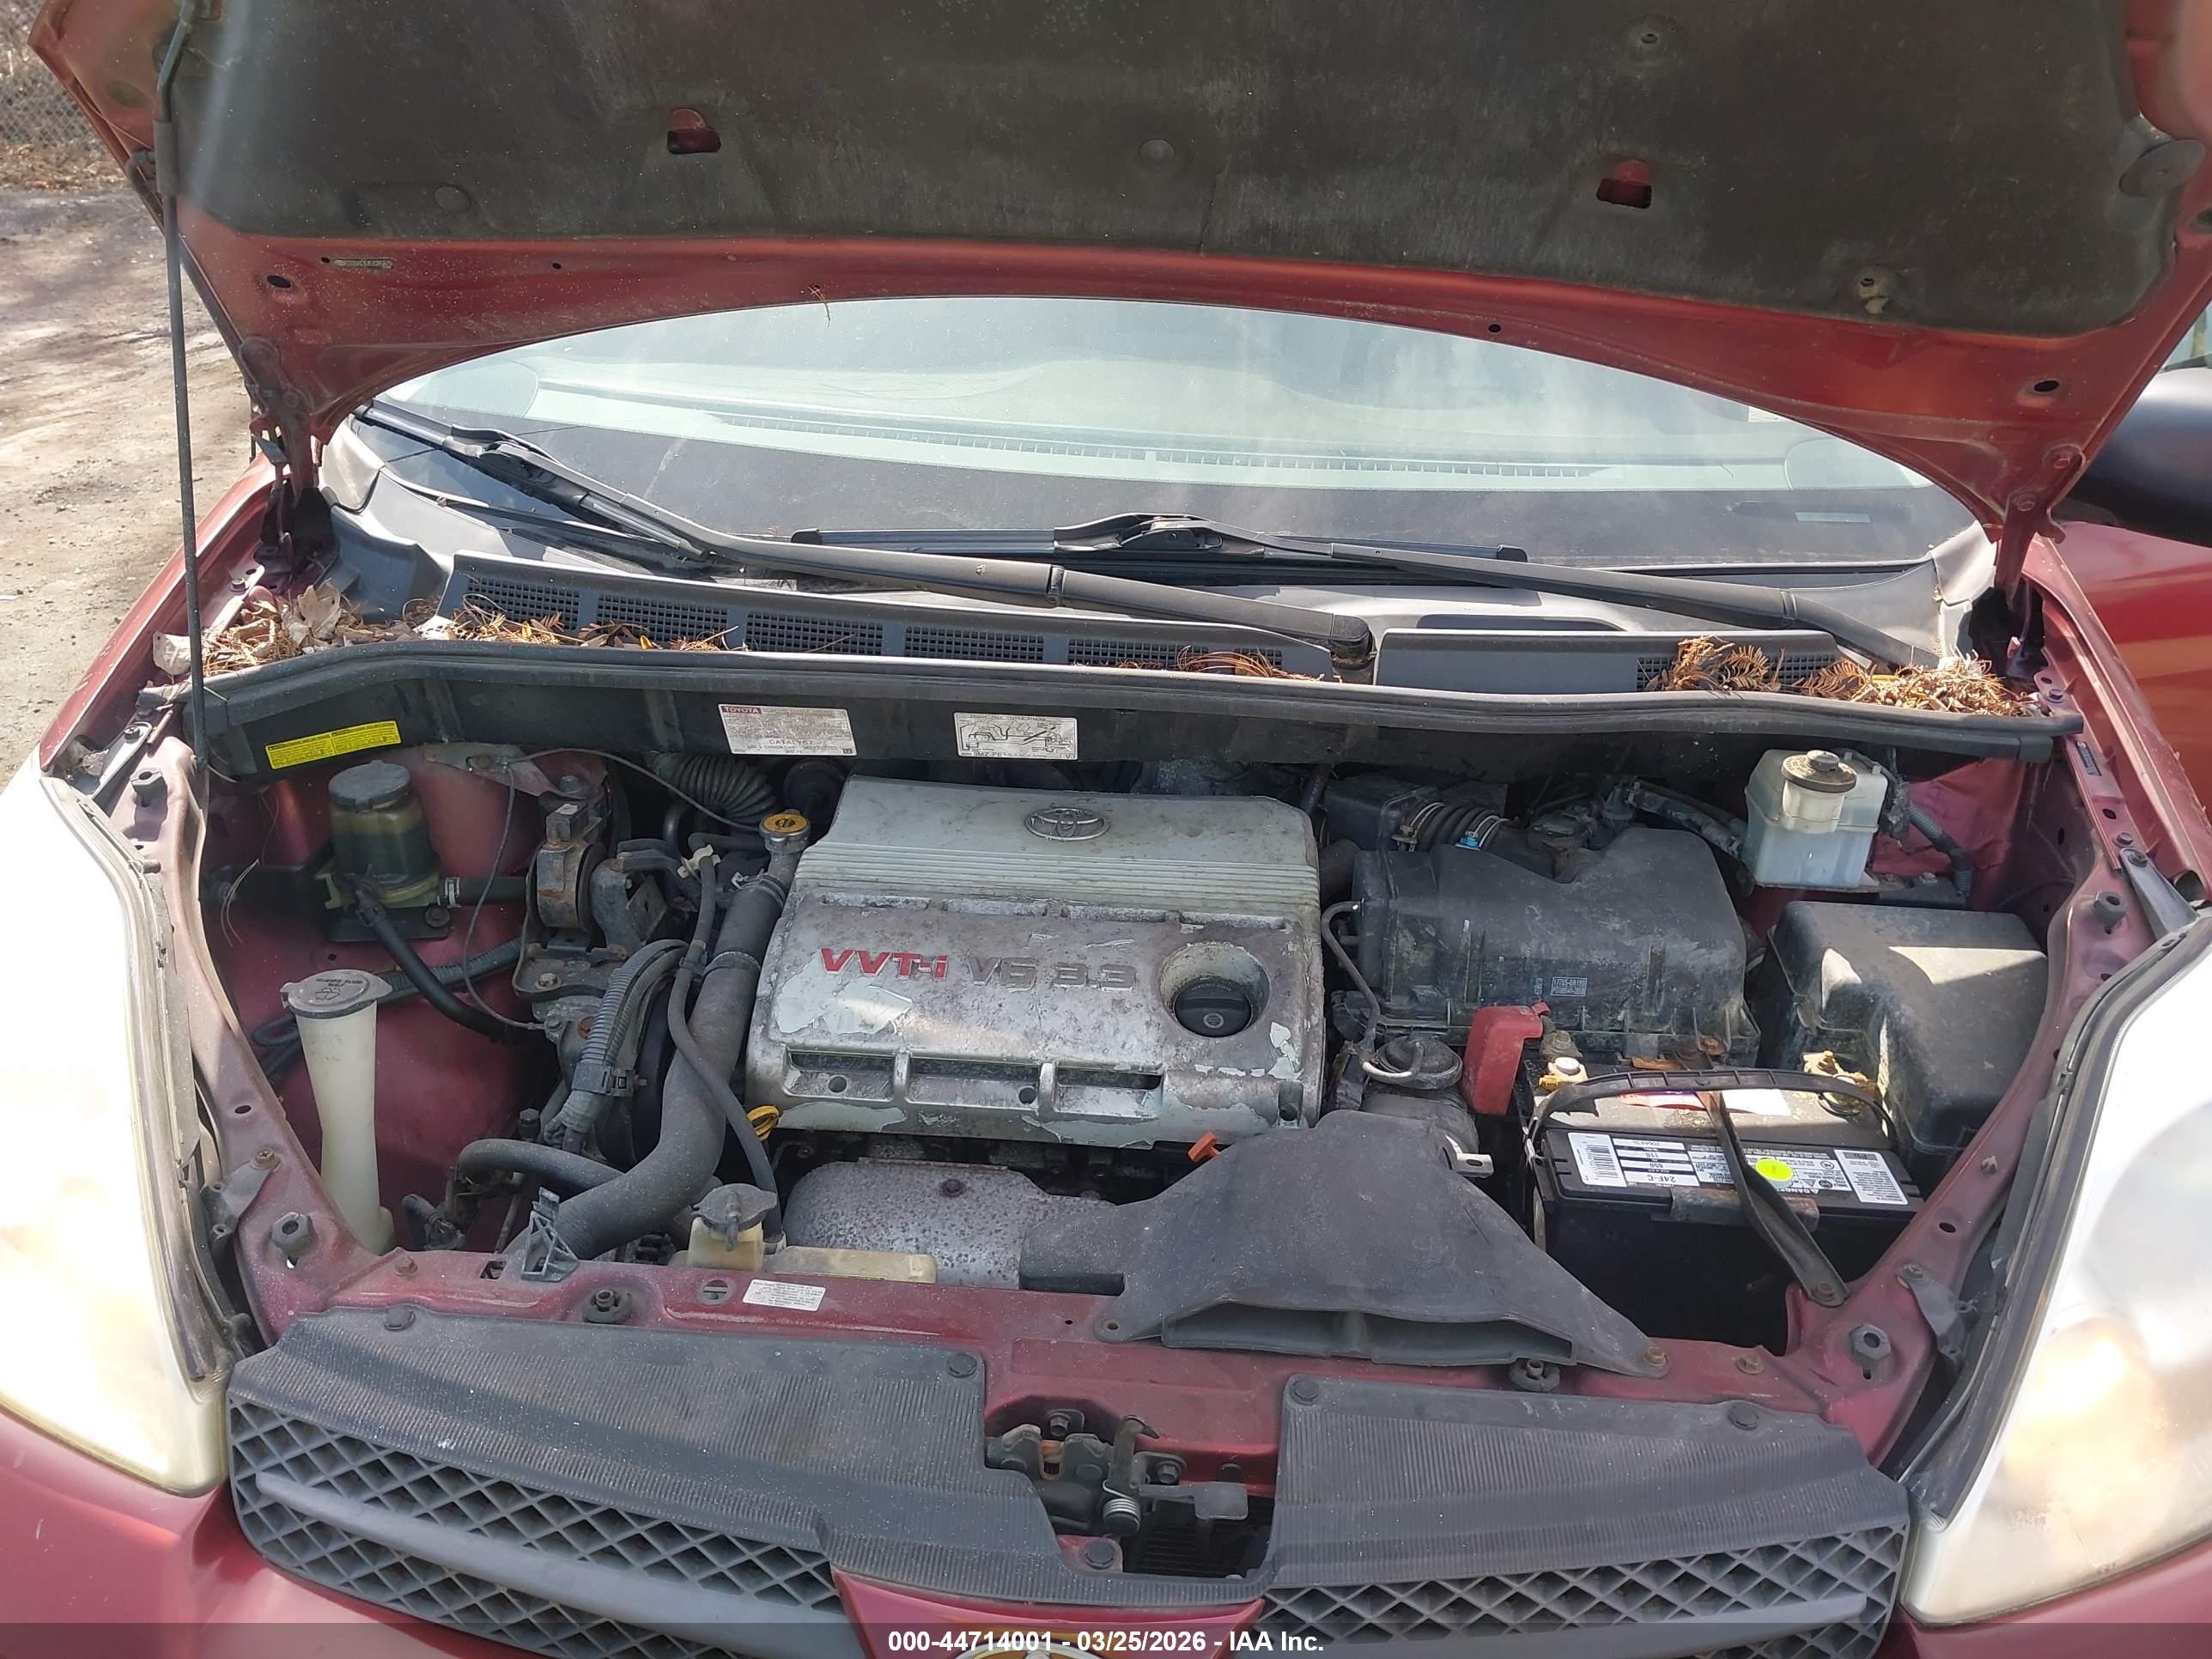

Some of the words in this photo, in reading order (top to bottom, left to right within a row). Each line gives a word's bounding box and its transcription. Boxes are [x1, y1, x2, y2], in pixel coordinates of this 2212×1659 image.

[820, 947, 948, 980] VVT-i
[967, 956, 1038, 993] V6
[1051, 961, 1138, 992] 3.3
[1647, 1175, 1676, 1183] 24F-C
